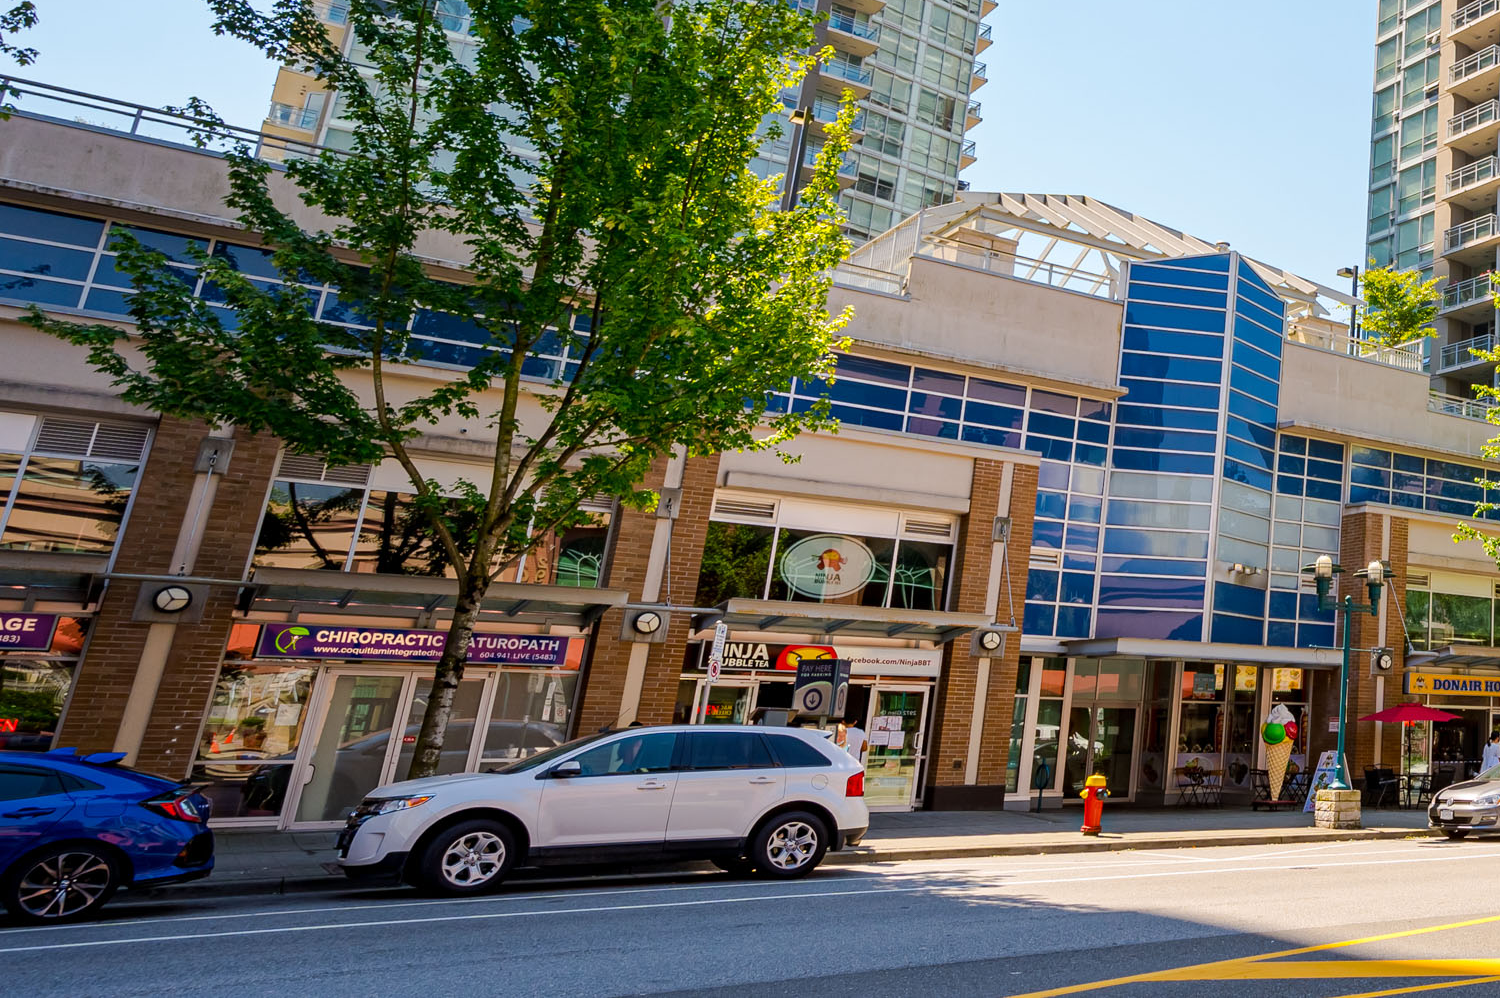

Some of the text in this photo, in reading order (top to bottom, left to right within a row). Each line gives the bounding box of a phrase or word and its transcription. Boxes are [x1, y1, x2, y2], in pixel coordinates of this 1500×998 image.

[316, 629, 560, 651] CHIROPRACTIC ATUROPATH
[531, 653, 557, 661] (5483)
[723, 643, 770, 660] INJA
[720, 657, 754, 667] UBBLE
[801, 664, 817, 672] PAY
[815, 664, 832, 672] HERE
[1433, 679, 1482, 692] DONAIR
